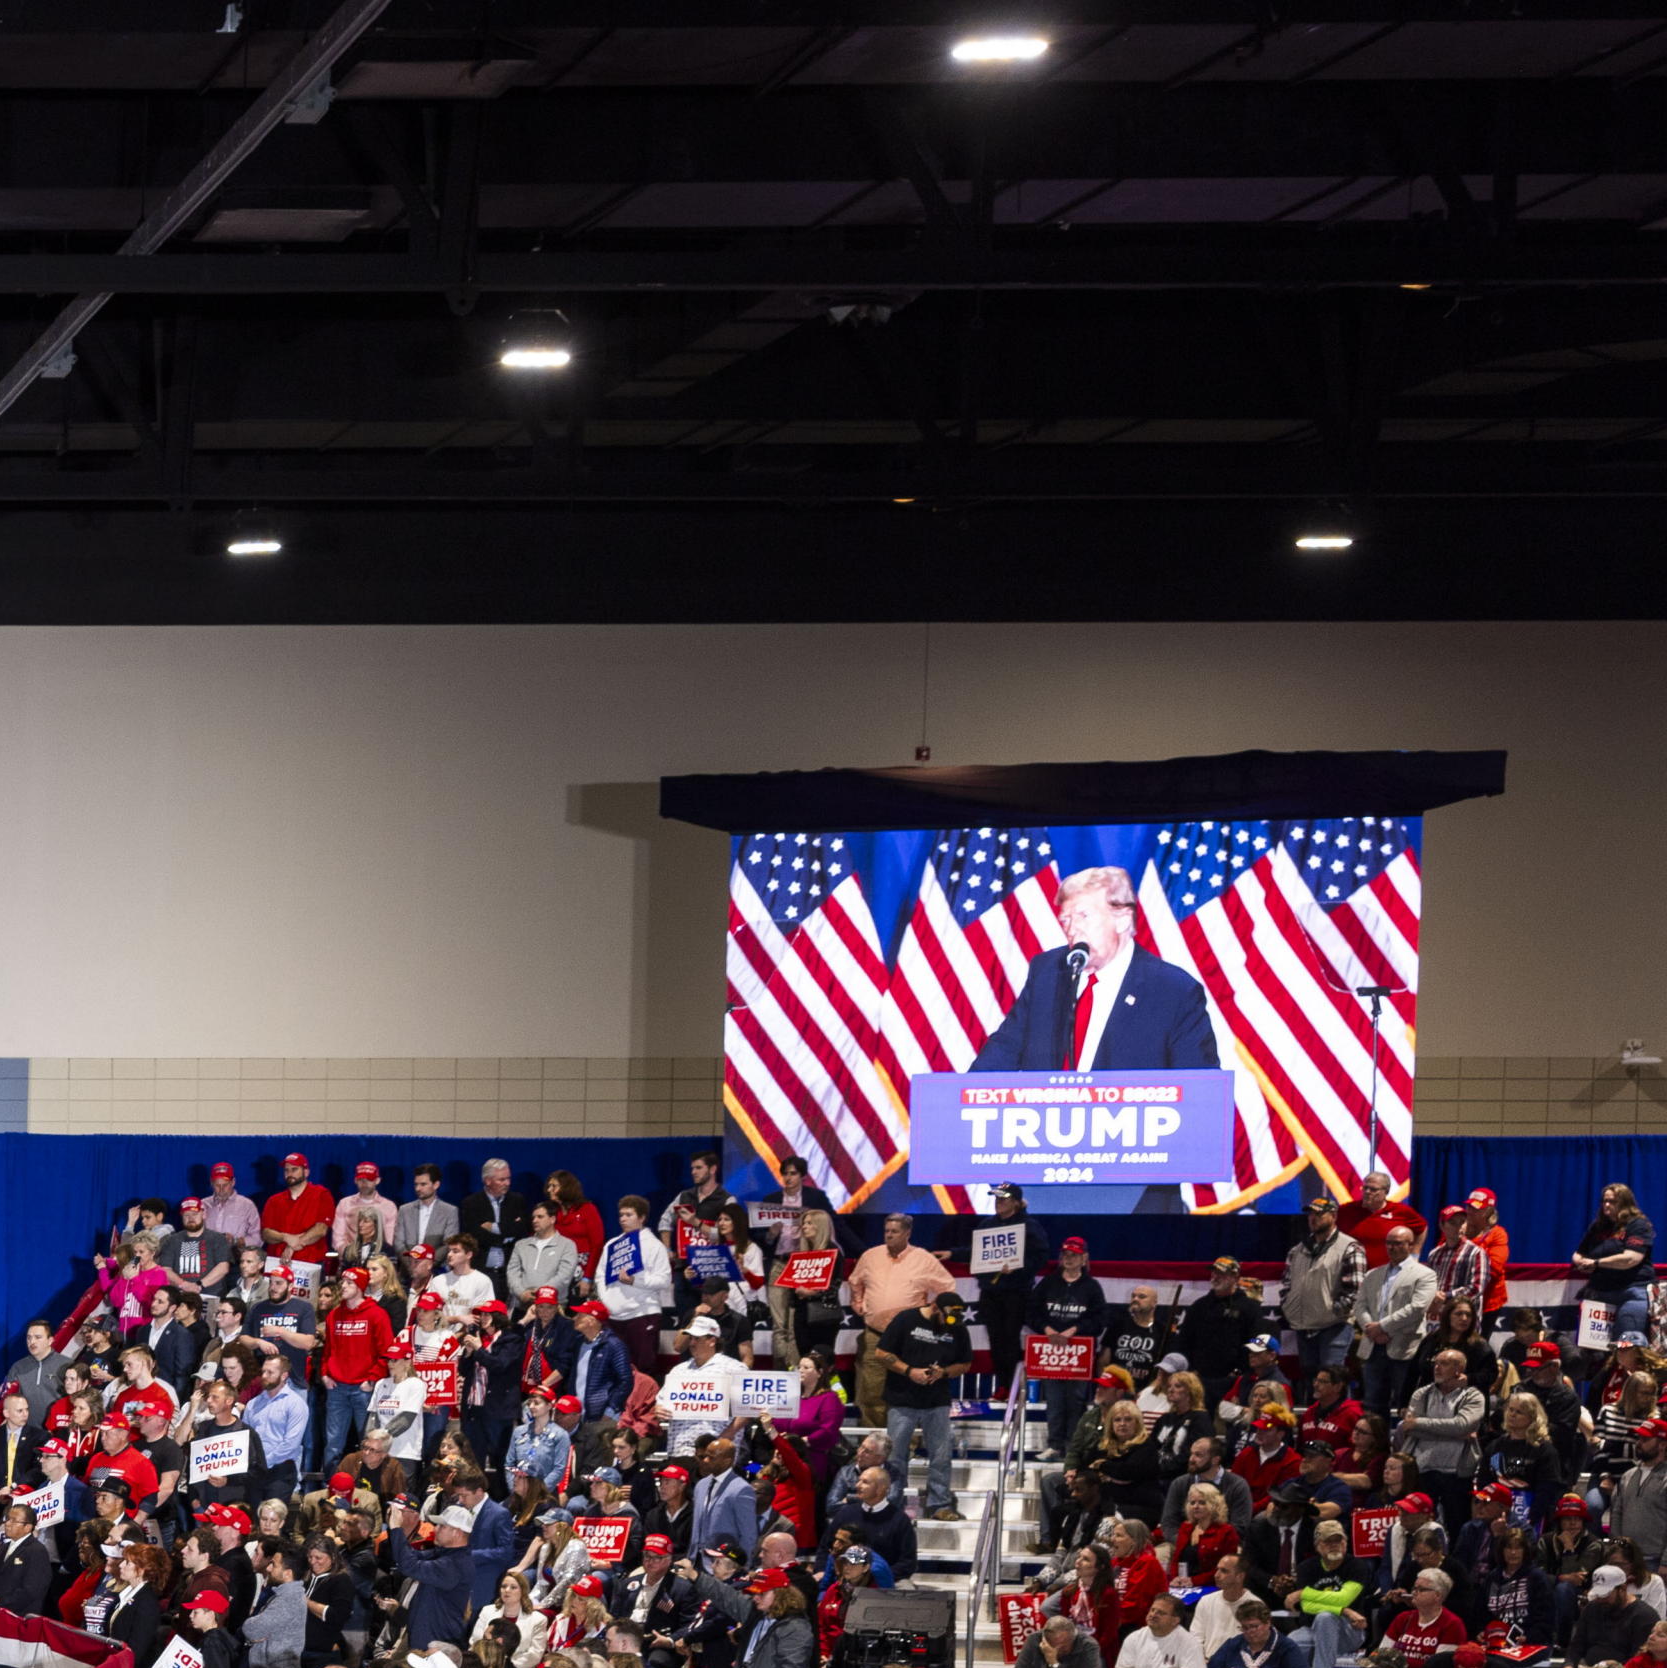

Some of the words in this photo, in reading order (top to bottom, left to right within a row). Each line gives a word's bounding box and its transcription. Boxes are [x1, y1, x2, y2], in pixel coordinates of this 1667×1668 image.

[965, 1088, 1009, 1103] TEXT
[1013, 1088, 1090, 1103] VIRGINIA
[1095, 1088, 1118, 1102] TO
[961, 1107, 1181, 1148] TRUMP
[971, 1153, 1010, 1164] MAKE
[1014, 1153, 1073, 1164] AMERICA
[1076, 1153, 1117, 1164] GREAT
[1120, 1153, 1168, 1164] AGAIN!
[1043, 1169, 1094, 1183] 2024
[982, 1232, 1017, 1249] FIRE
[982, 1247, 1017, 1260] BIDEN
[792, 1257, 832, 1270] TRUMP
[792, 1268, 822, 1278] 2024
[1047, 1302, 1086, 1313] TRUMP
[1117, 1334, 1154, 1351] GOD
[1032, 1343, 1087, 1356] TRUMP
[1039, 1354, 1079, 1366] 2024
[428, 1381, 445, 1392] 24
[681, 1382, 715, 1391] VOTE
[743, 1379, 787, 1393] FIRE
[670, 1392, 724, 1402] DONALD
[741, 1394, 787, 1405] BIDEN
[673, 1402, 718, 1412] TRUMP
[204, 1440, 233, 1453] VOTE
[195, 1448, 243, 1464] DONALD
[198, 1458, 238, 1473] TRUMP
[27, 1491, 52, 1506] VOTE
[577, 1525, 625, 1537] TRUMP
[1368, 1530, 1388, 1542] 20
[1022, 1606, 1036, 1636] 024
[1007, 1600, 1023, 1657] TRUMP
[1422, 1636, 1438, 1646] GO
